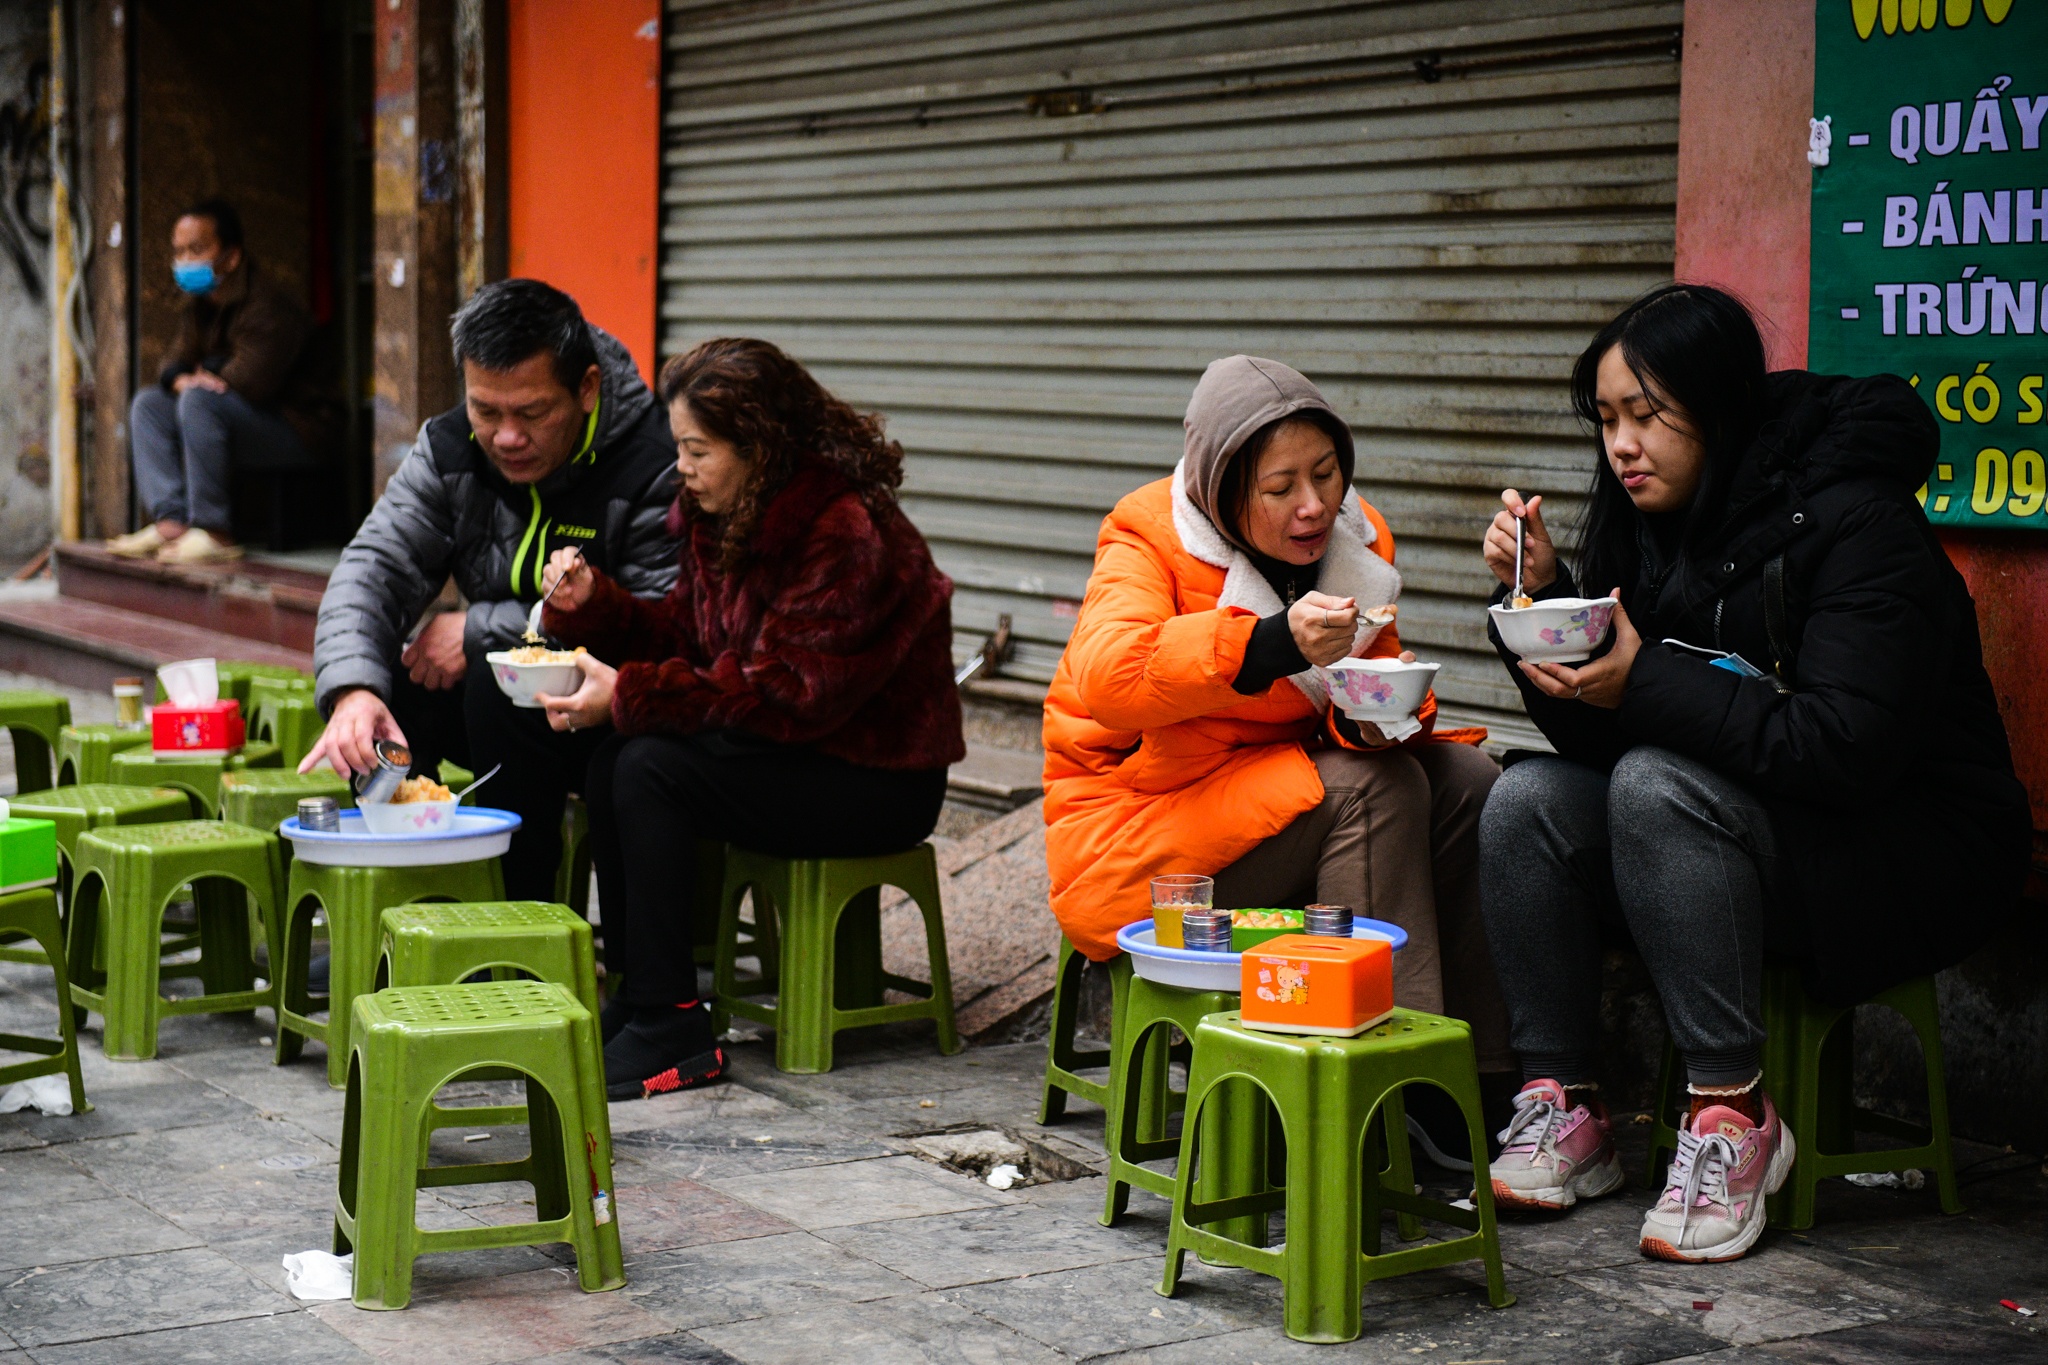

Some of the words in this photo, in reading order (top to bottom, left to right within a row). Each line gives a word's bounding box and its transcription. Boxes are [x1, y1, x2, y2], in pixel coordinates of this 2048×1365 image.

[1889, 75, 2048, 165] QUẨY
[1874, 266, 2048, 336] TRỨN
[1935, 362, 2001, 424] CÓ
[2017, 375, 2048, 424] S
[1970, 448, 2048, 517] 09
